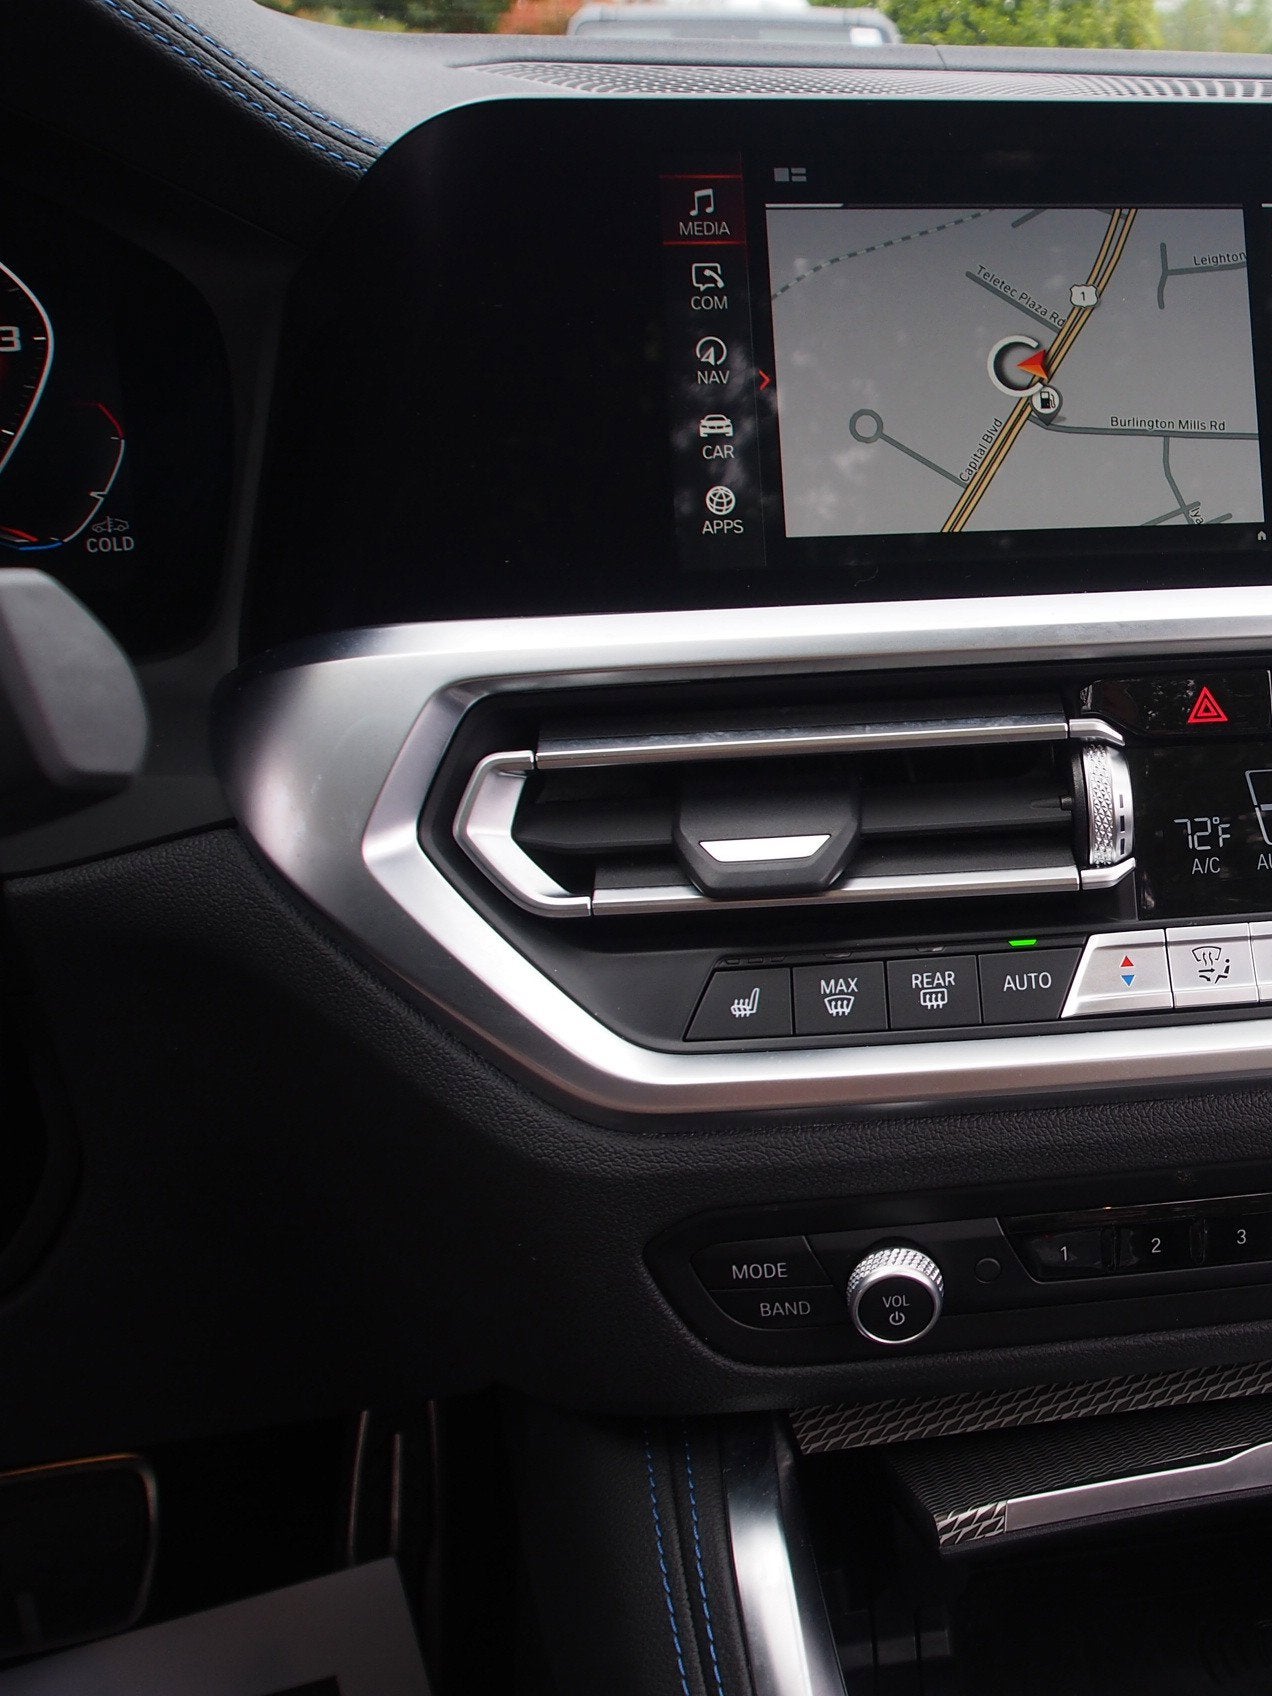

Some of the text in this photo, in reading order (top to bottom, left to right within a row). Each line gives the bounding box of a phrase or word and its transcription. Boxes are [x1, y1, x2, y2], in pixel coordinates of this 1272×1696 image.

[679, 221, 731, 236] MEDIA
[1193, 250, 1247, 267] Leighton
[690, 296, 728, 310] COM
[976, 264, 1067, 327] Teletec Plaza Rd
[697, 370, 730, 385] NAV
[1110, 416, 1226, 431] Burlington Mills Rd
[702, 445, 735, 459] CAR
[959, 418, 1003, 482] Capital Blvd
[702, 519, 744, 535] APPS
[86, 536, 134, 553] COLD
[1191, 857, 1221, 874] A/C
[820, 977, 858, 995] MAX
[912, 971, 956, 988] REAR
[1003, 972, 1052, 991] AUTO
[1236, 1229, 1247, 1244] 3
[1059, 1246, 1068, 1261] 1
[1151, 1238, 1161, 1253] 2
[732, 1262, 788, 1280] MODE
[760, 1301, 811, 1317] BAND
[882, 1294, 910, 1308] VOL
